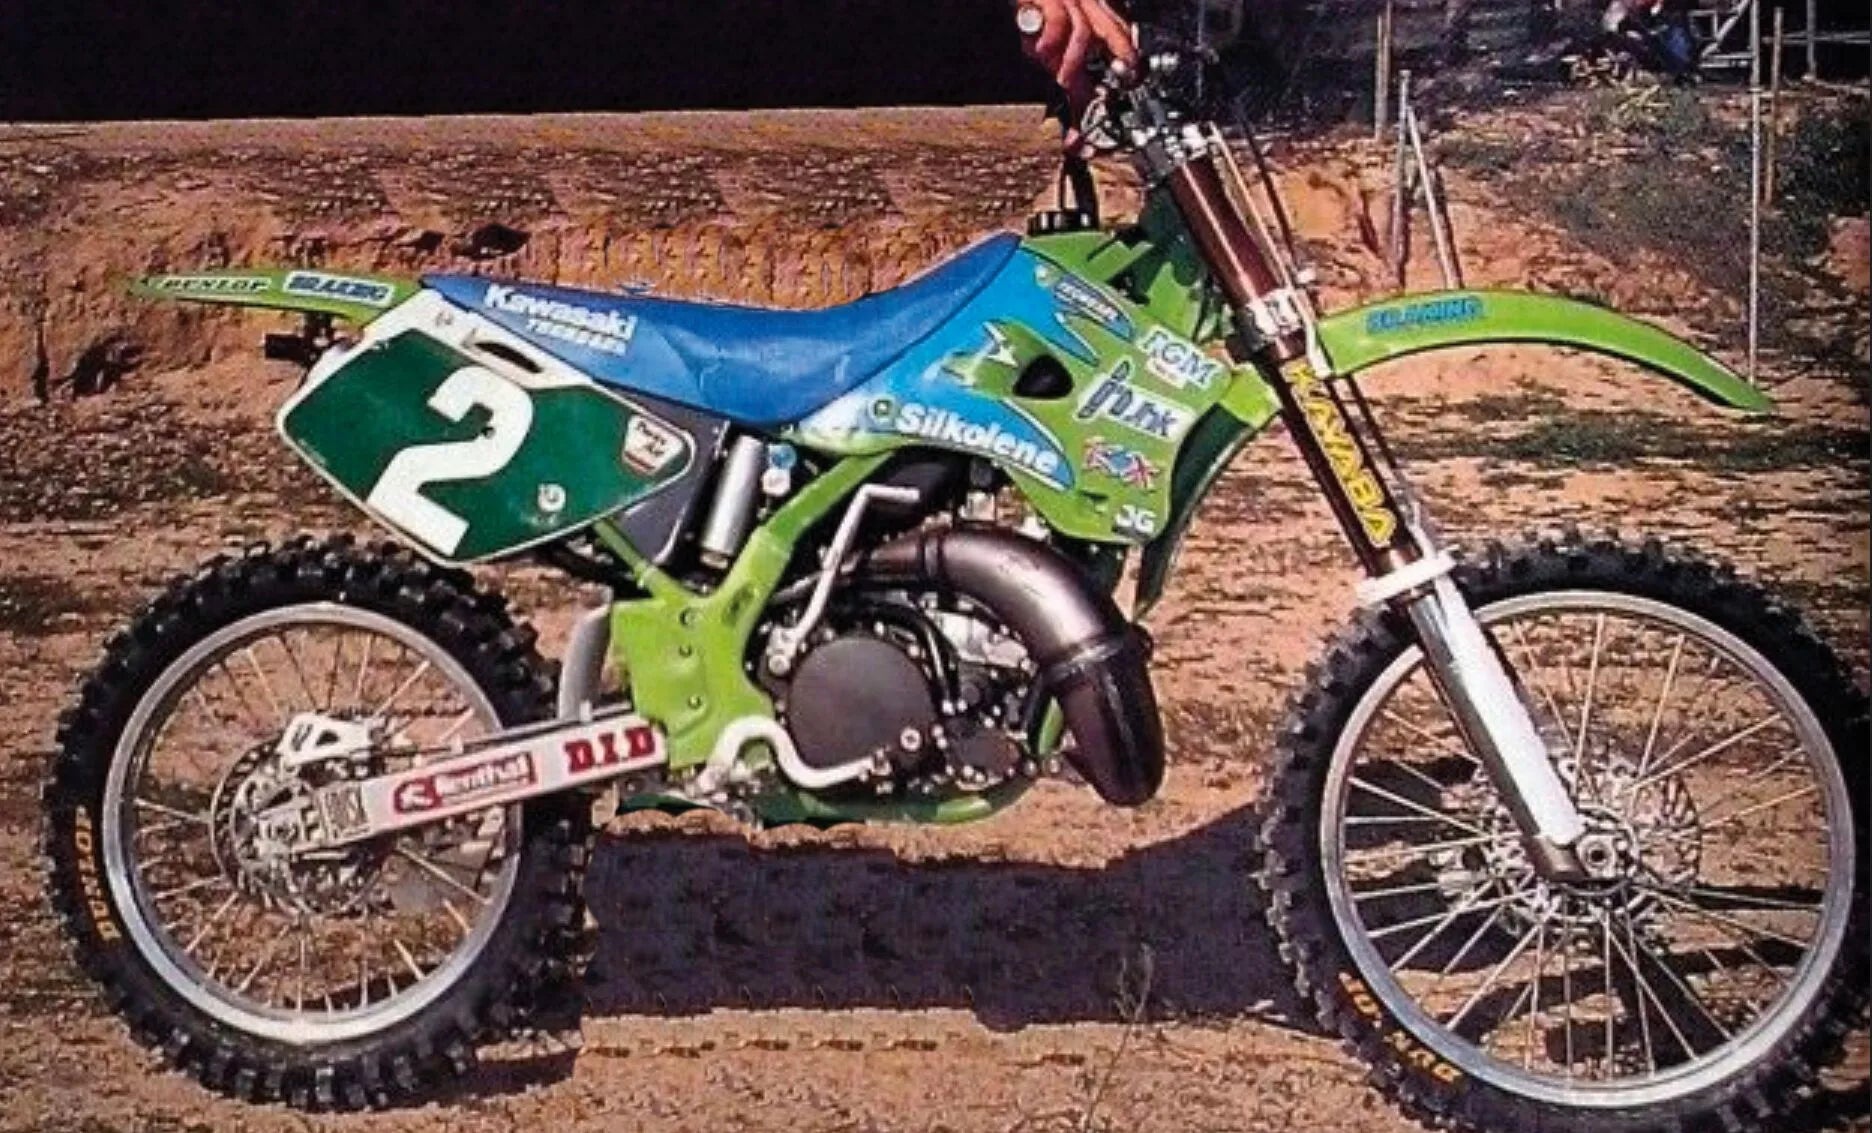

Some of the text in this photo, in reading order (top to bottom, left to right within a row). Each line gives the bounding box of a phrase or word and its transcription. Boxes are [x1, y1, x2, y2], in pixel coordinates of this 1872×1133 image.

[485, 283, 639, 340] Kawasaki
[366, 366, 533, 556] 2
[899, 402, 1060, 472] Silkolene
[1280, 358, 1398, 548] KAYABA
